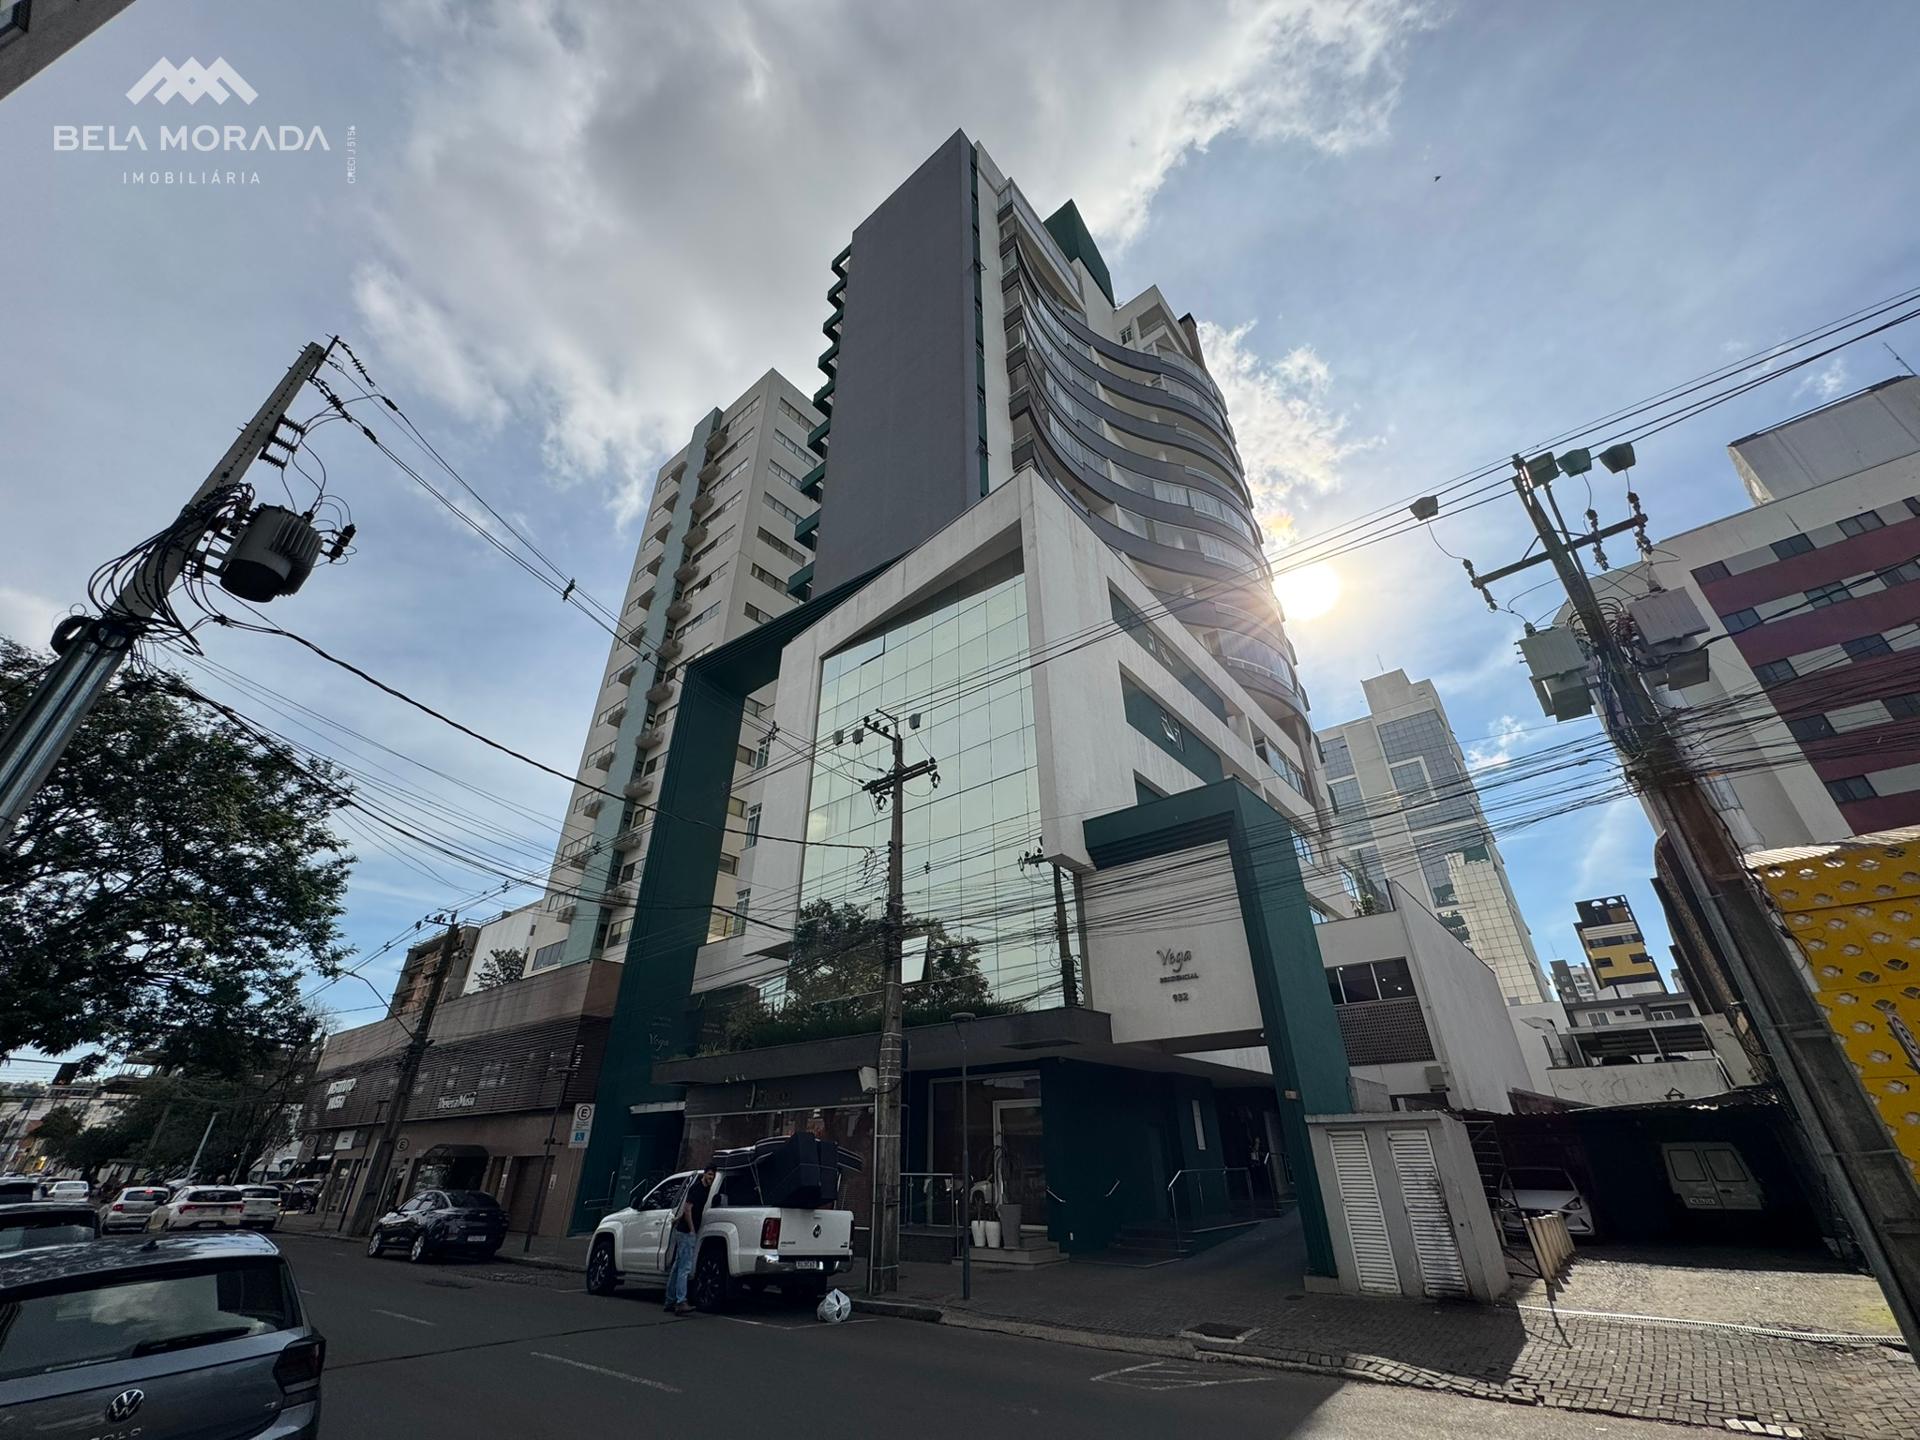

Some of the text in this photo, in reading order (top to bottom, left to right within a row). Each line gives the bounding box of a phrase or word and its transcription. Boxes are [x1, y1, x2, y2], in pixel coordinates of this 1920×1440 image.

[1156, 948, 1192, 973] Vega
[1172, 992, 1189, 1002] 932
[90, 1427, 142, 1440] OLO
